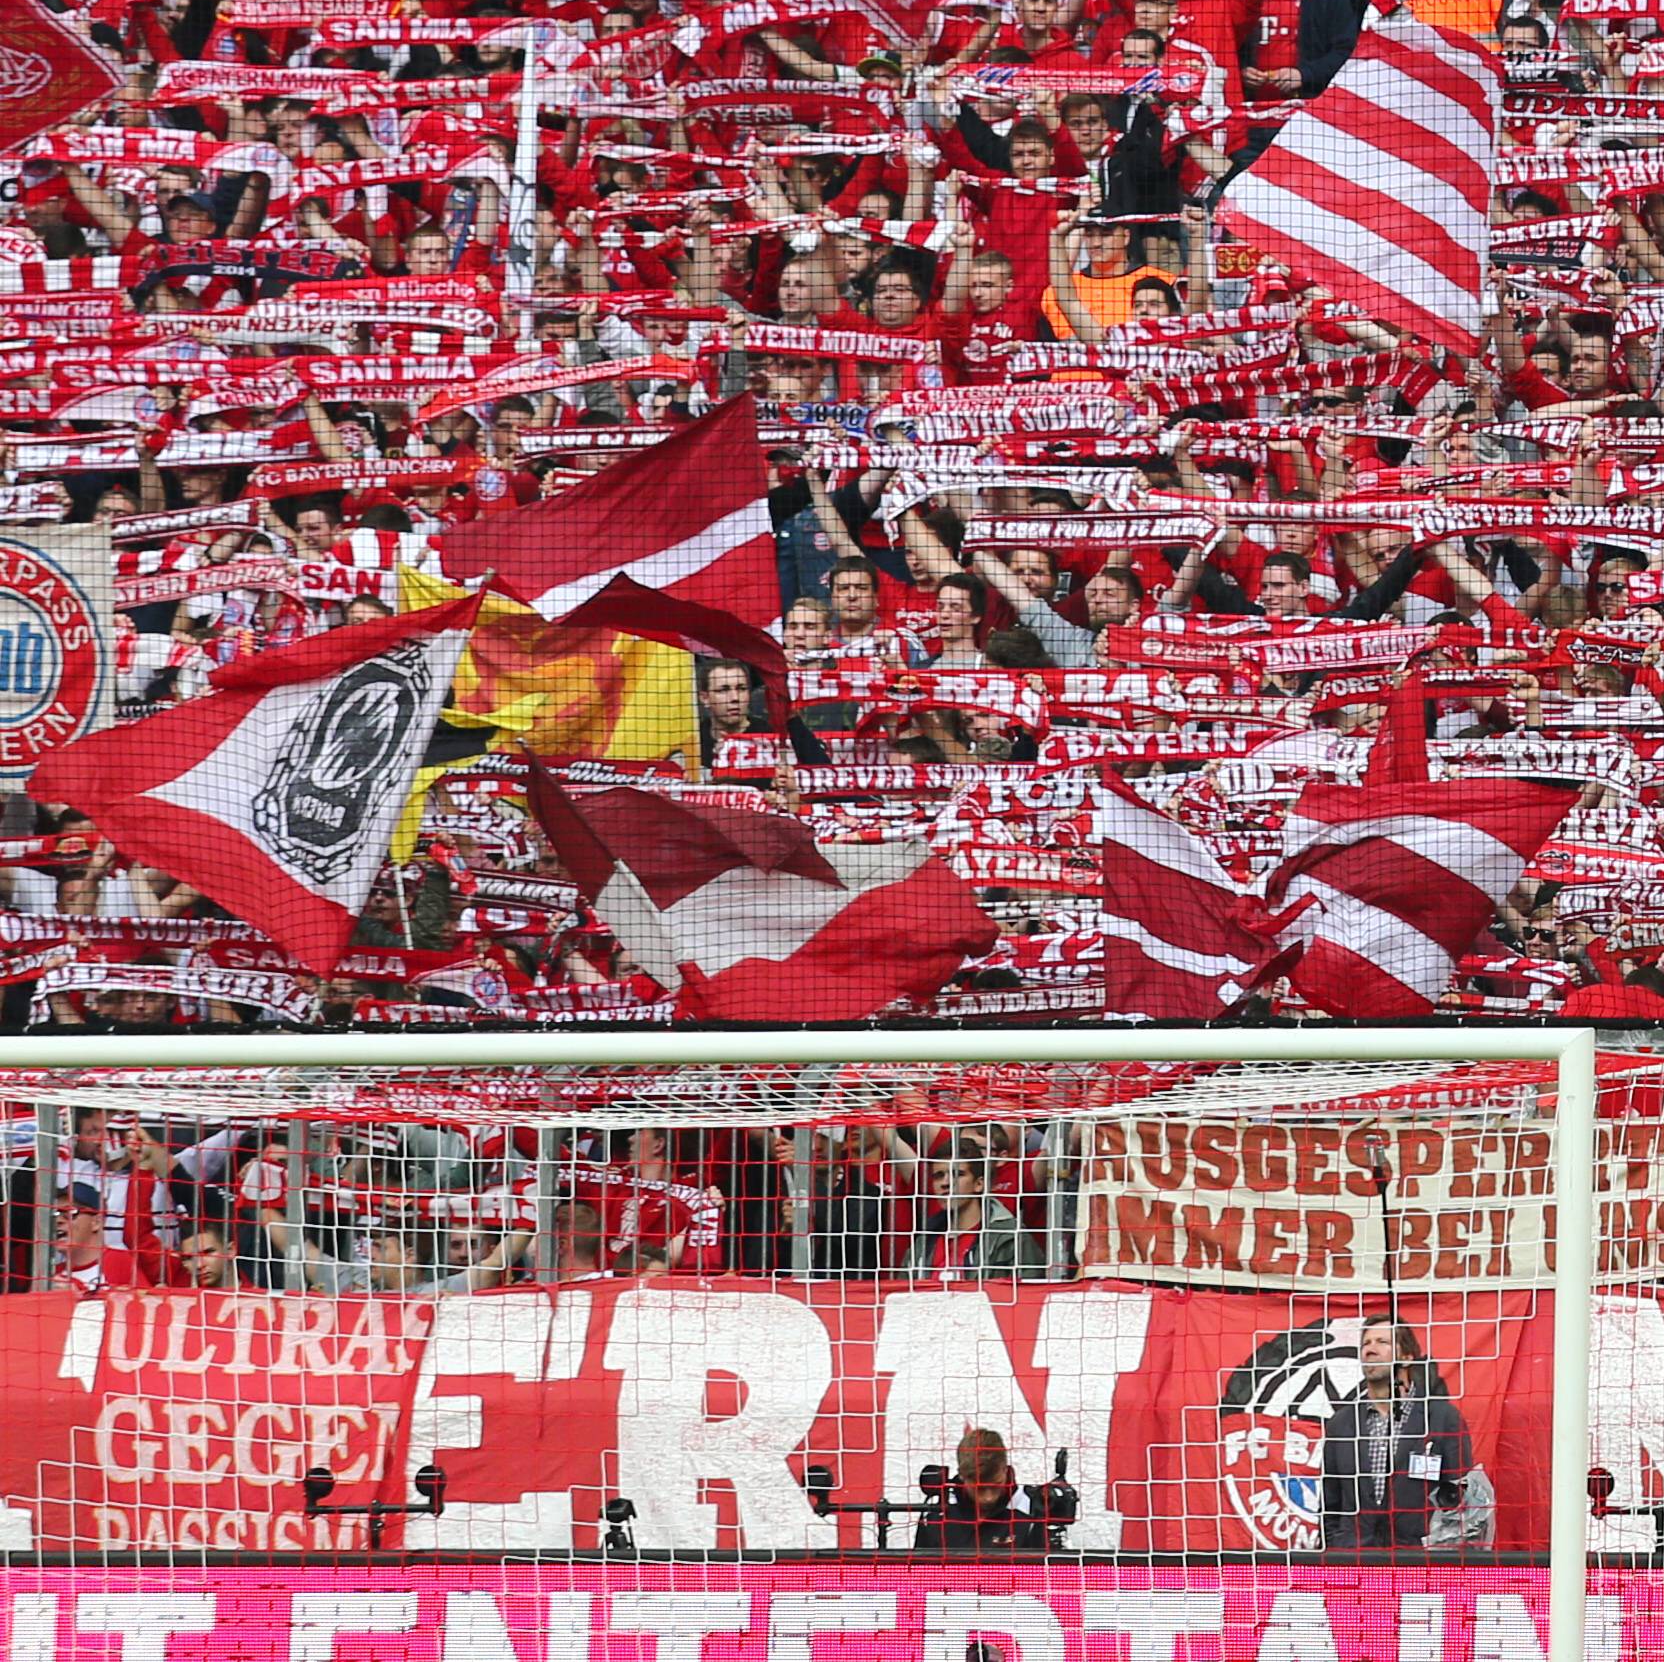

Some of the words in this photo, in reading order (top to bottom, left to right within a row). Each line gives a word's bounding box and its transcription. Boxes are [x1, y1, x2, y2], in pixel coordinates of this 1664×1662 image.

[329, 19, 401, 43] SAN
[408, 18, 474, 40] MIA
[309, 359, 393, 384] SAN
[401, 355, 476, 380] MIA
[1063, 728, 1247, 758] BAYERN
[1083, 1195, 1357, 1279] IMMER
[1387, 1205, 1517, 1279] BEI
[405, 1288, 1154, 1550] ERN
